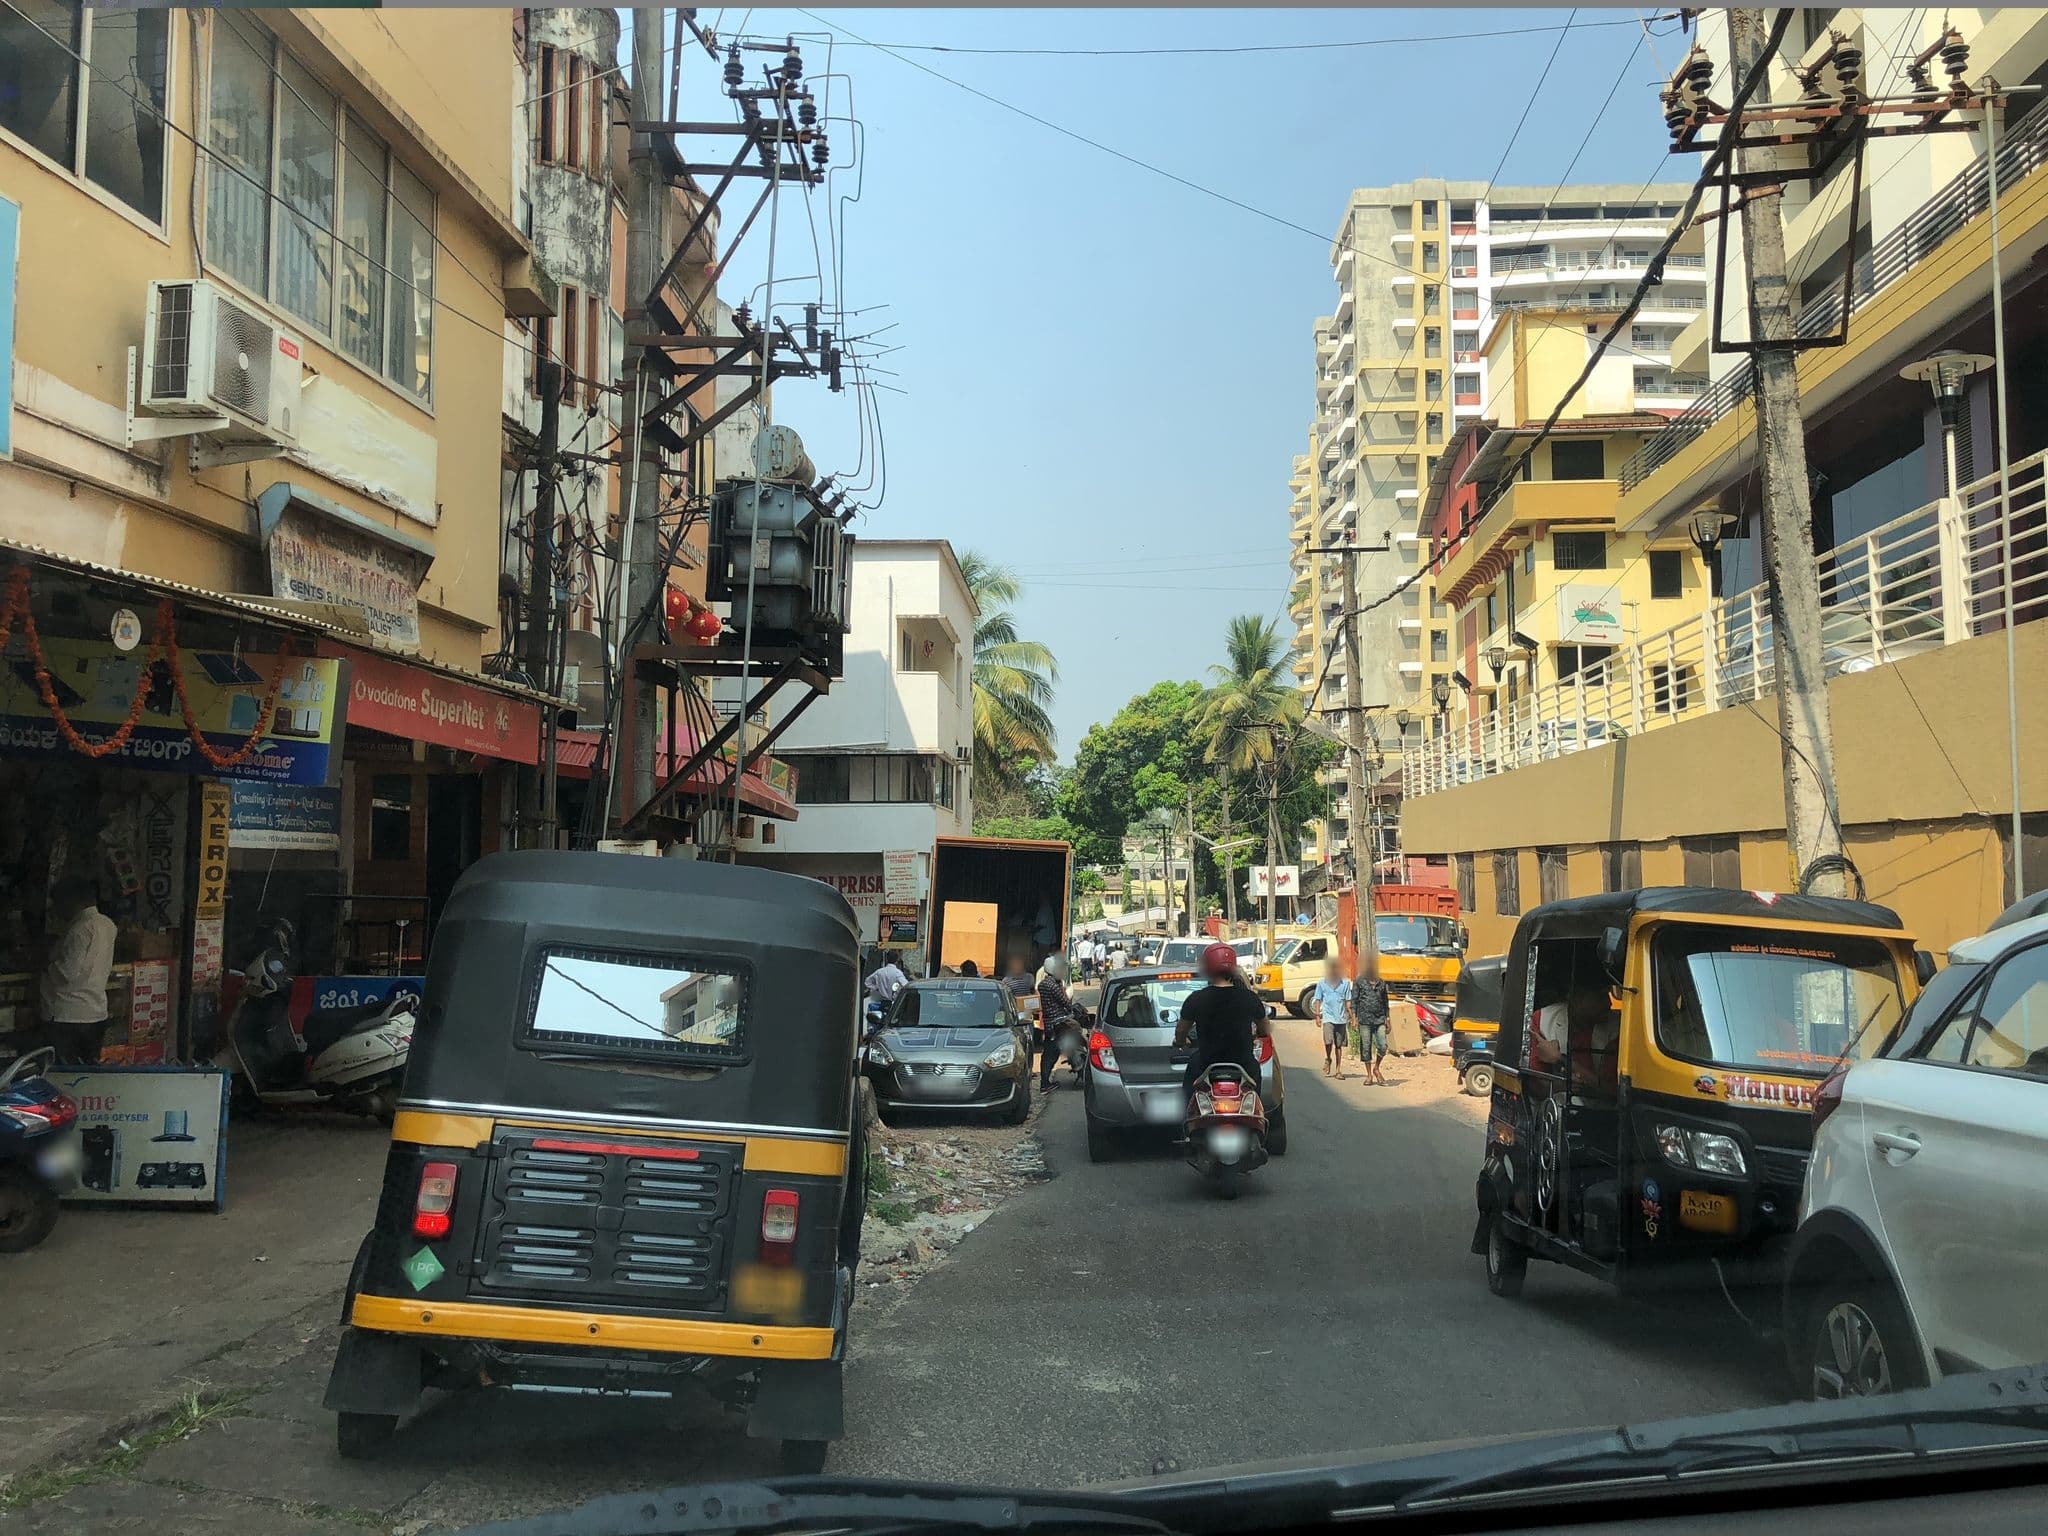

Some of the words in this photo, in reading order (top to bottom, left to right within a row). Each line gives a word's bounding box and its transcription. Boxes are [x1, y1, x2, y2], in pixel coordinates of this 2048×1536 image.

[290, 579, 323, 600] GENTS
[367, 606, 402, 627] TAILORS
[366, 685, 417, 713] vodafone
[421, 688, 485, 730] SuperNet
[244, 768, 260, 777] Gas
[262, 768, 291, 780] Geyser
[203, 802, 227, 903] XEROX
[838, 875, 883, 894] PRASA
[90, 1113, 110, 1122] GAS
[112, 1113, 149, 1122] GEYSER
